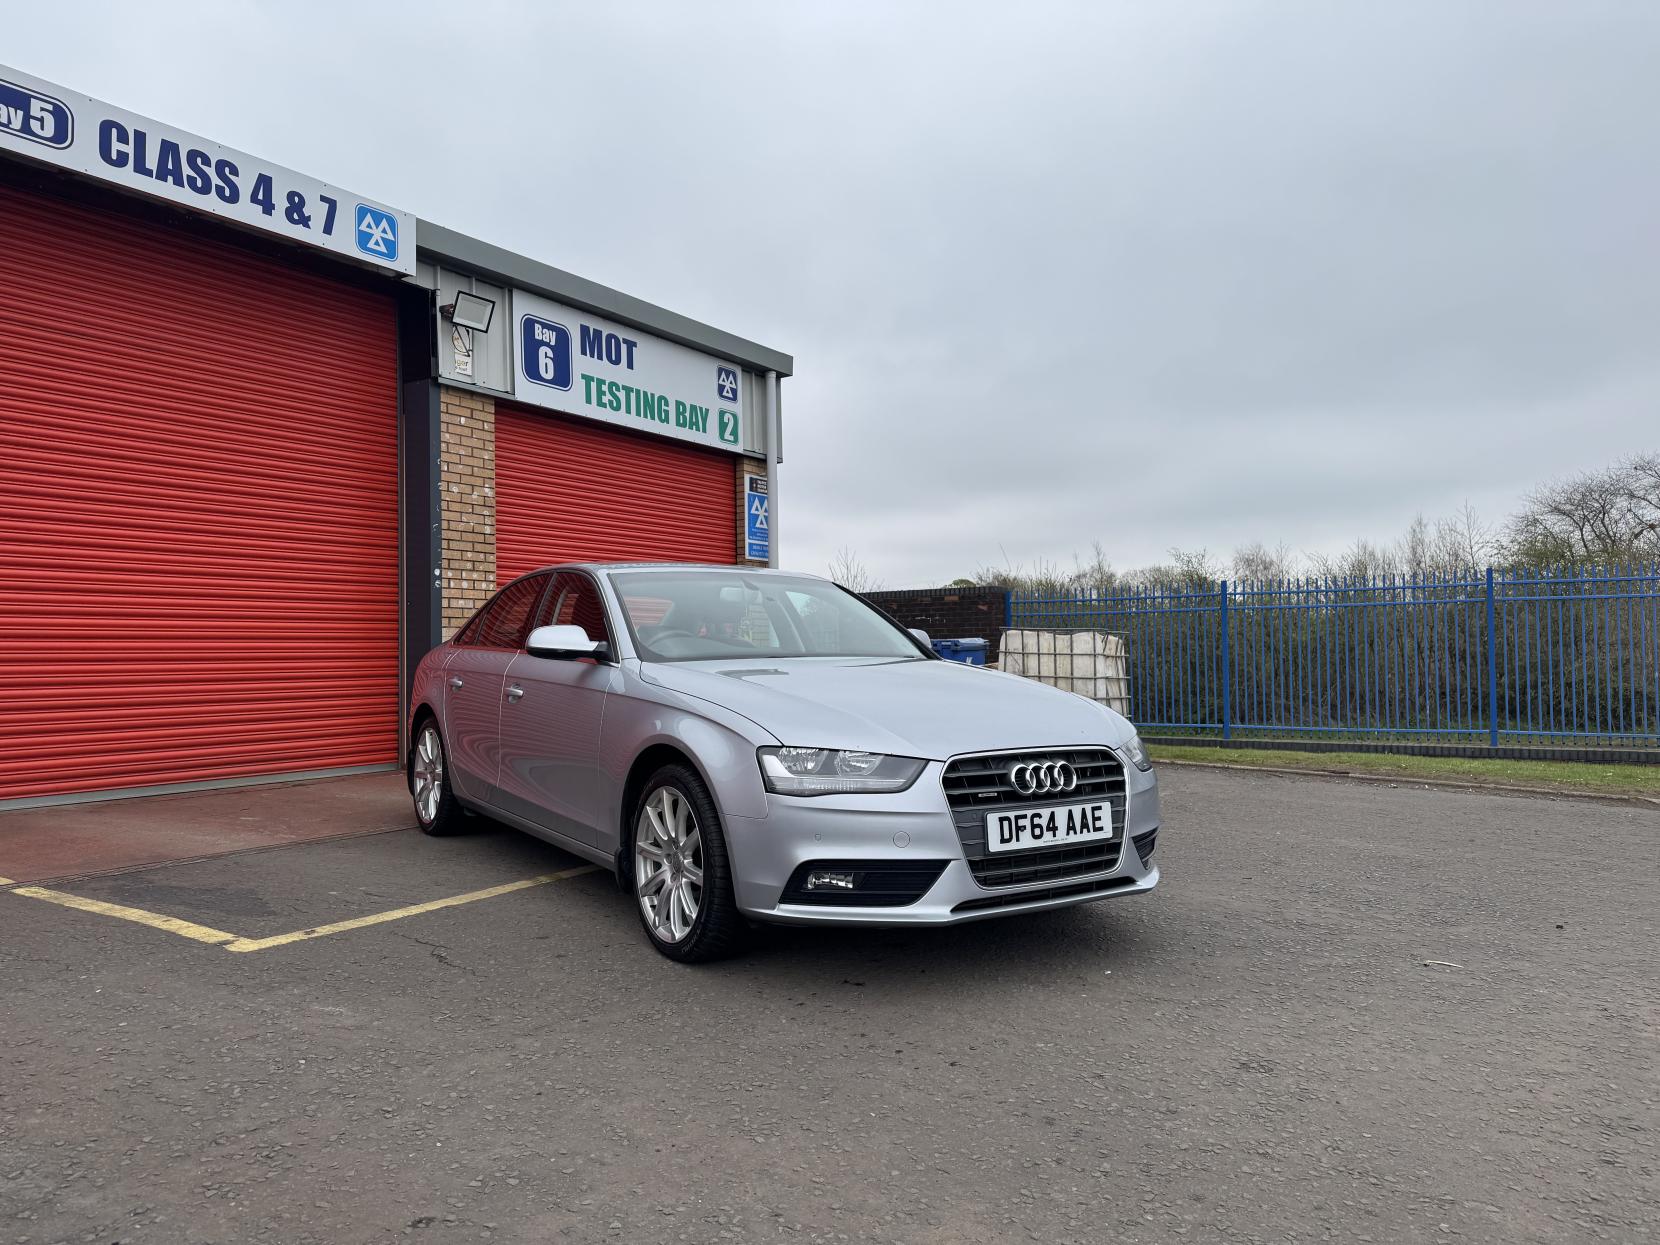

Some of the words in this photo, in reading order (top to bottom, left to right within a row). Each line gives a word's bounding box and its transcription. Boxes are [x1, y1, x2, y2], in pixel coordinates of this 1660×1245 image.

[29, 98, 55, 138] 5
[99, 119, 240, 205] CLASS
[249, 172, 276, 217] 4
[284, 190, 312, 229] &
[319, 194, 338, 236] 7
[534, 322, 557, 346] Bay
[579, 324, 638, 371] MOT
[538, 345, 555, 381] 6
[580, 373, 670, 425] TESTING
[675, 399, 710, 434] BAY
[722, 413, 735, 441] 2
[998, 810, 1059, 845] DF64
[1065, 805, 1104, 836] AAE
